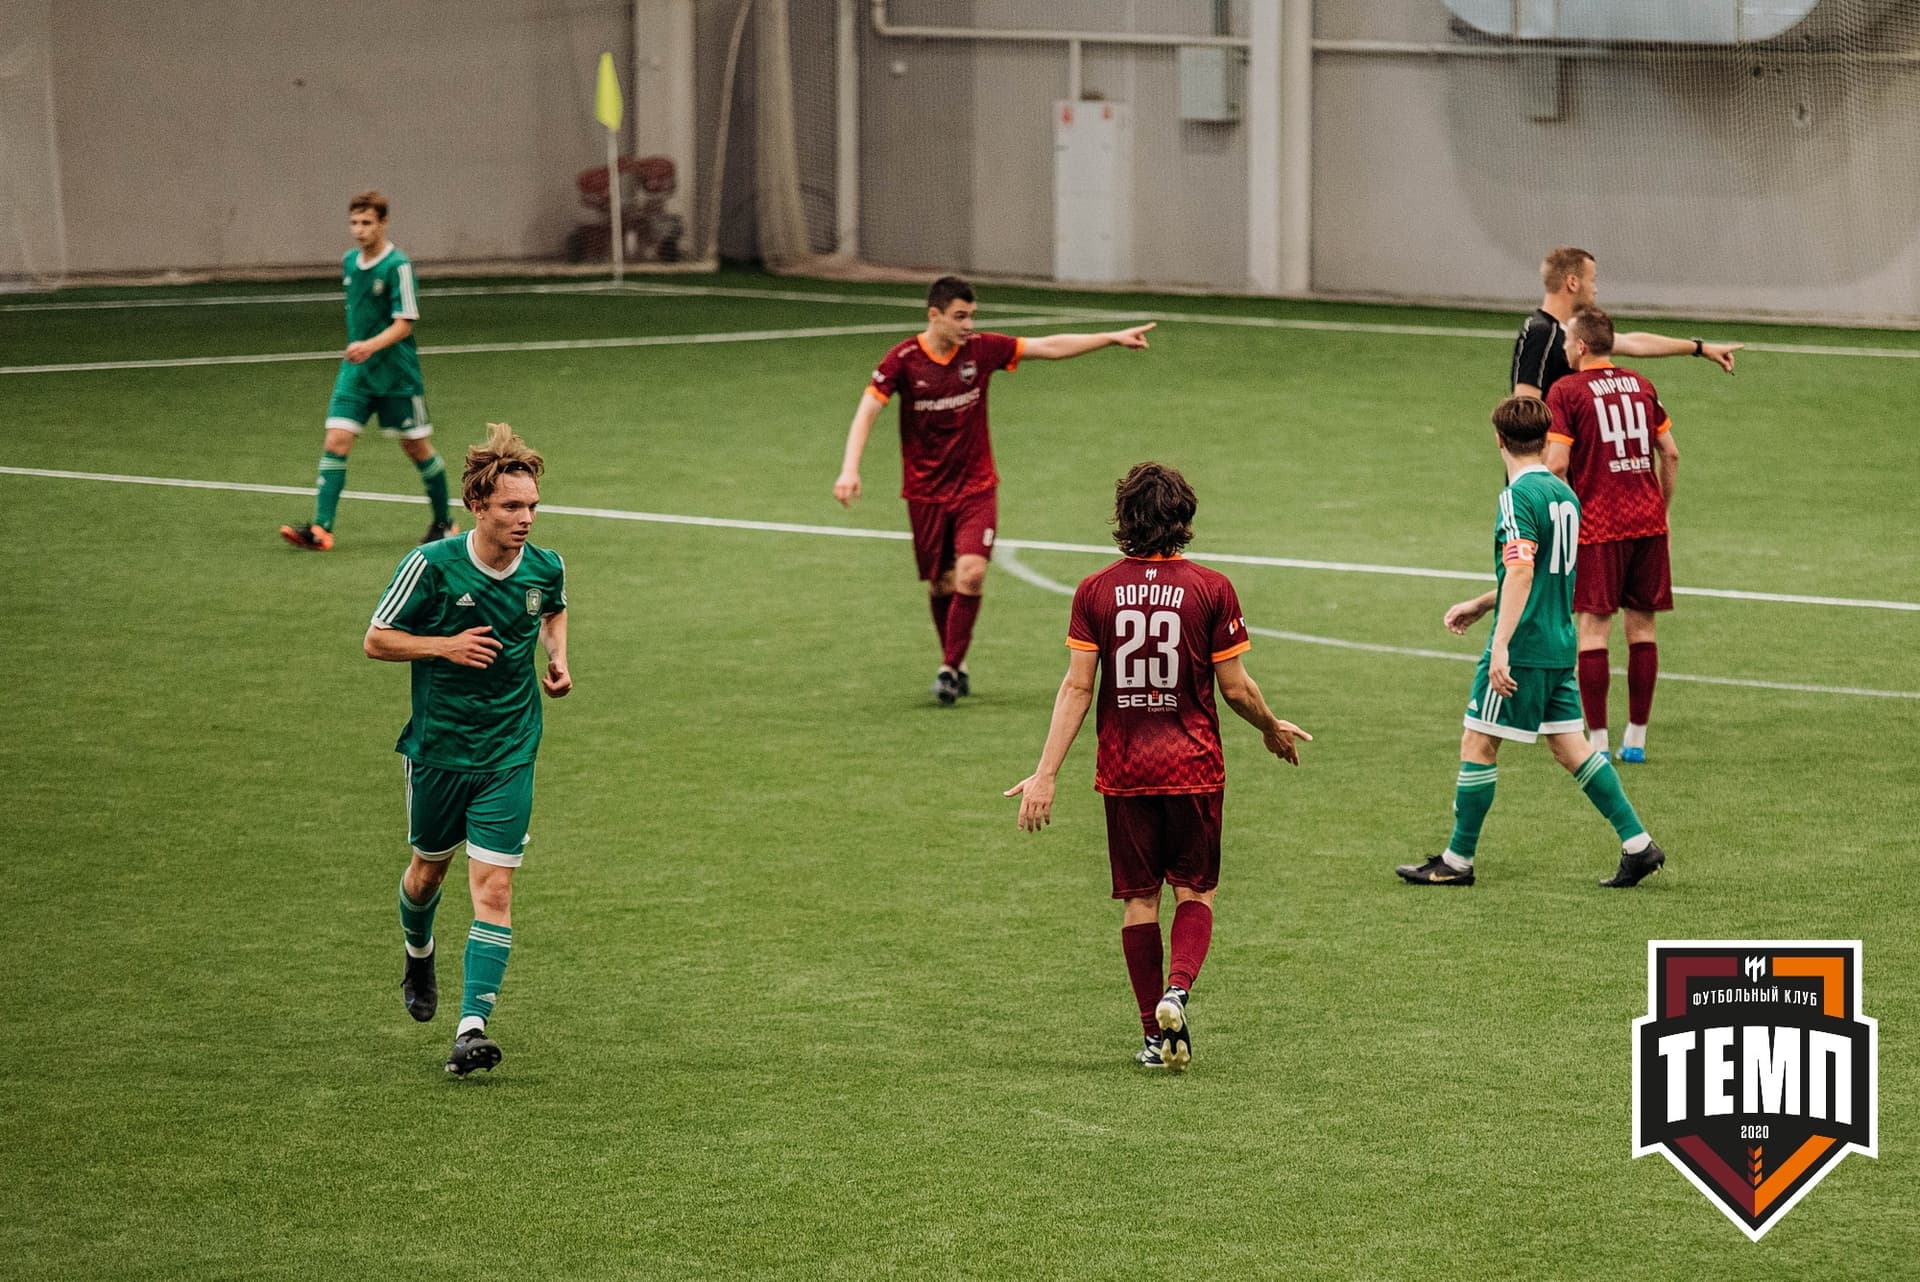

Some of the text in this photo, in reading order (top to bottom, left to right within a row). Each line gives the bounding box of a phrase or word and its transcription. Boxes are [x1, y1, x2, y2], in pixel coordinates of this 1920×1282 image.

[1593, 394, 1650, 458] 44
[1608, 456, 1651, 473] SEUS
[1548, 501, 1580, 576] 10
[1115, 584, 1185, 609] ВОРОНА
[1115, 609, 1181, 689] 23
[1117, 693, 1178, 709] SEUS
